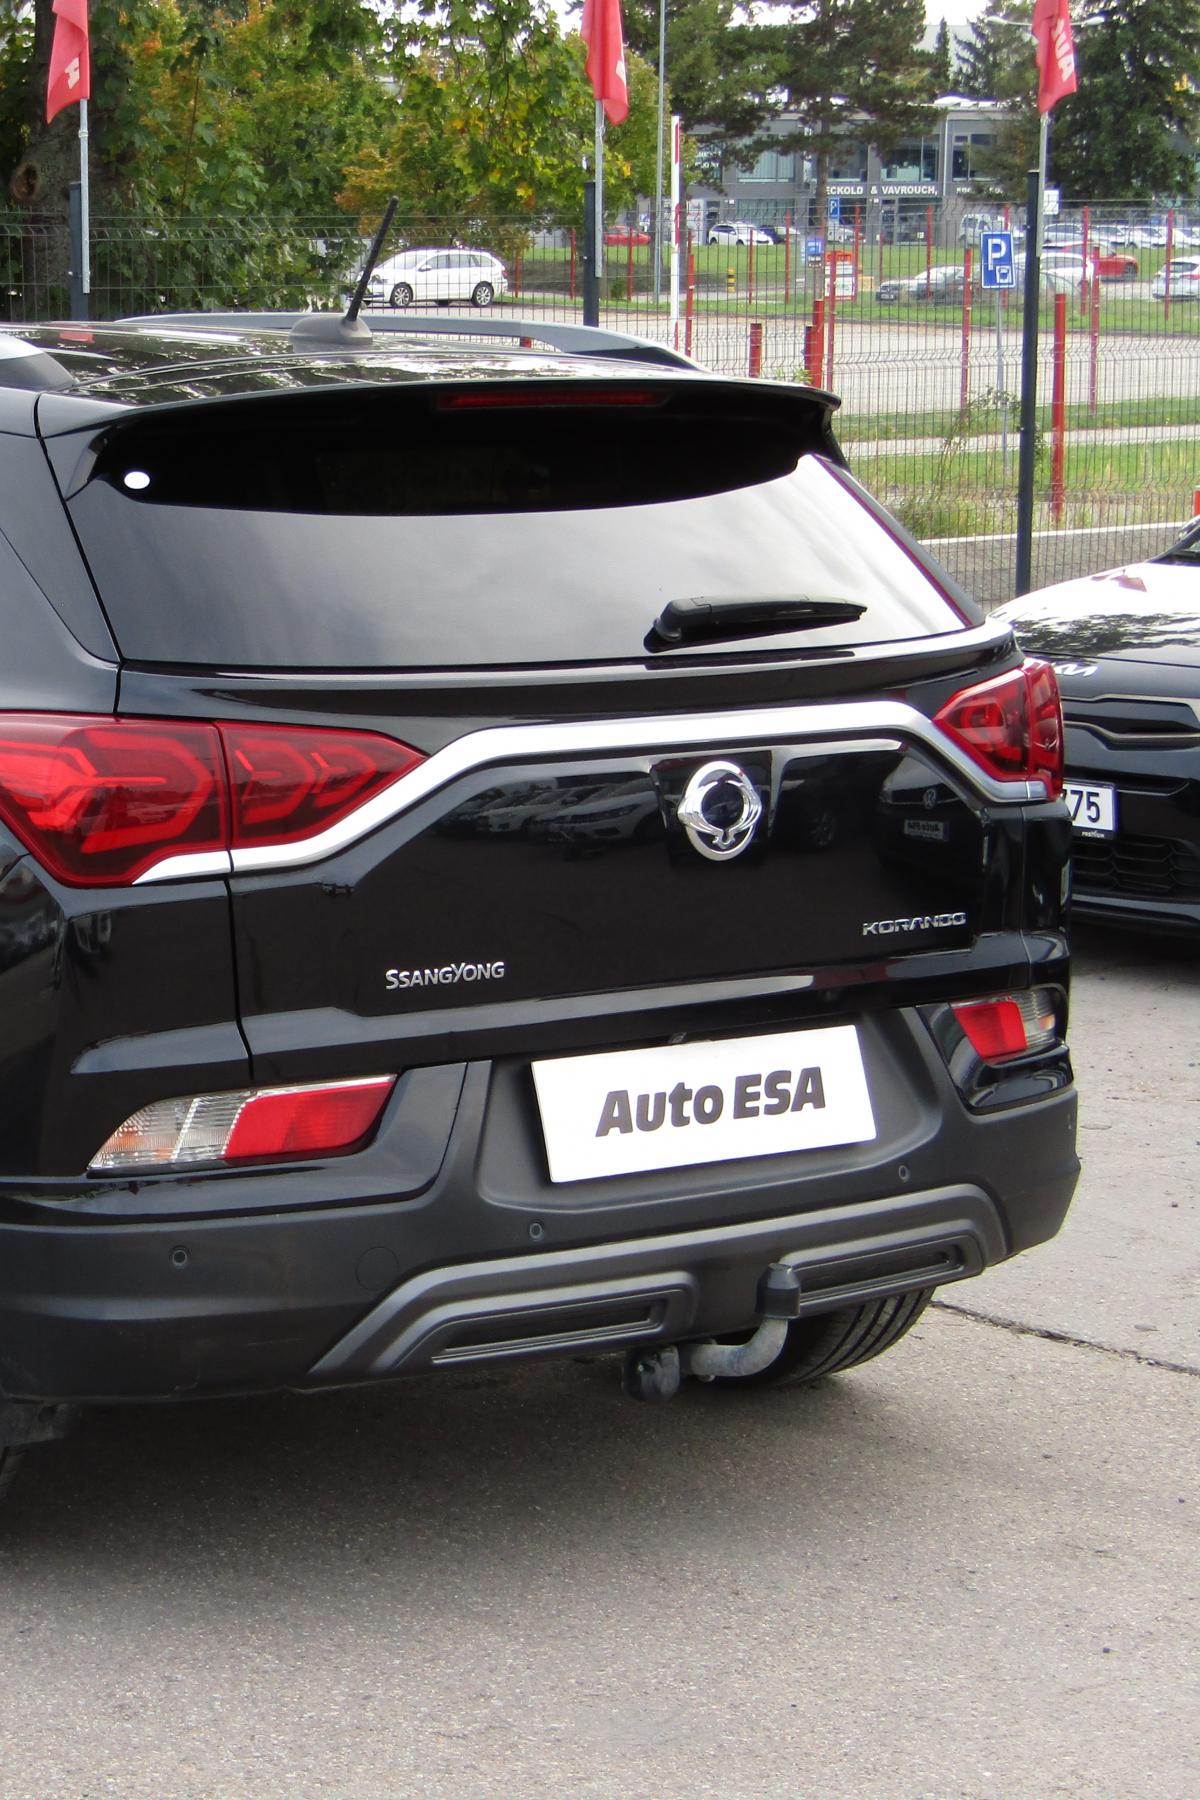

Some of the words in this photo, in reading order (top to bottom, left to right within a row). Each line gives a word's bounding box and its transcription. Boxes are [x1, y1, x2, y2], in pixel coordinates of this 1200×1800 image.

[870, 185, 878, 195] &
[881, 185, 938, 197] VAVROUCH,
[987, 238, 1007, 271] P
[1063, 788, 1100, 823] 75
[862, 912, 967, 936] KORANDO
[595, 1081, 724, 1137] Auto
[733, 1066, 826, 1119] ESA
